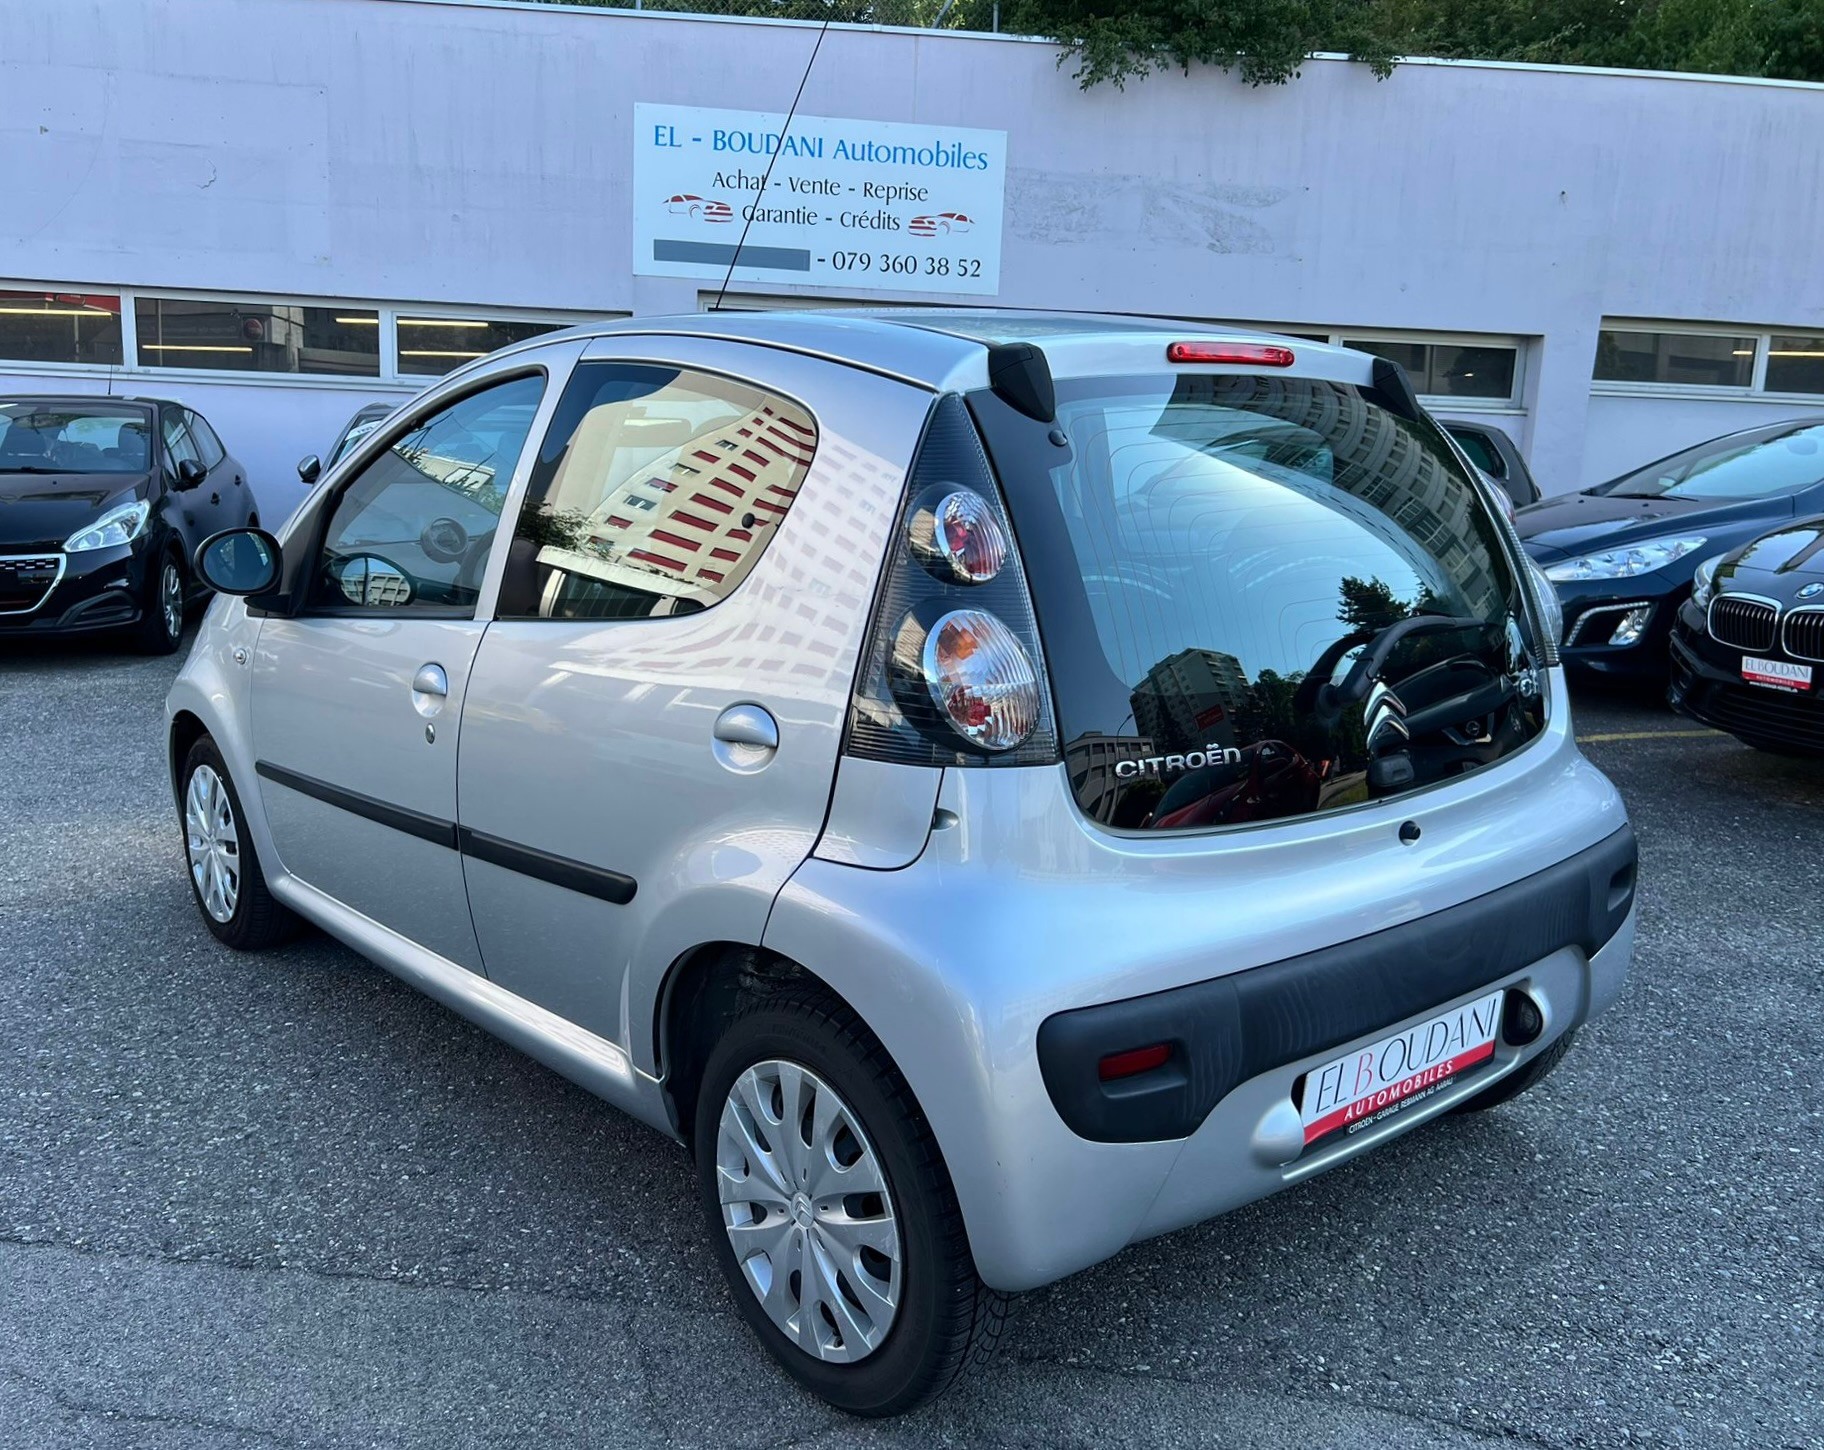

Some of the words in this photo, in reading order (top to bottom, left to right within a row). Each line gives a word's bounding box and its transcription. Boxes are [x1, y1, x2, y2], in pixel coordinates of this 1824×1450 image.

[653, 124, 682, 148] EL
[713, 129, 824, 158] BOUDANI
[833, 138, 988, 170] Automobiles
[712, 169, 767, 191] Achat
[788, 176, 841, 196] Vente
[863, 181, 928, 206] Reprise
[742, 204, 818, 226] Garantie
[840, 210, 900, 231] Crédits
[832, 251, 871, 272] 079
[880, 255, 917, 275] 360
[925, 256, 950, 276] 38
[958, 258, 981, 278] 52
[1758, 660, 1809, 678] BOUDANI
[1316, 1062, 1348, 1113] EL
[1353, 998, 1497, 1096] BOUDANI
[1345, 1060, 1454, 1121] AUTOMOBILES
